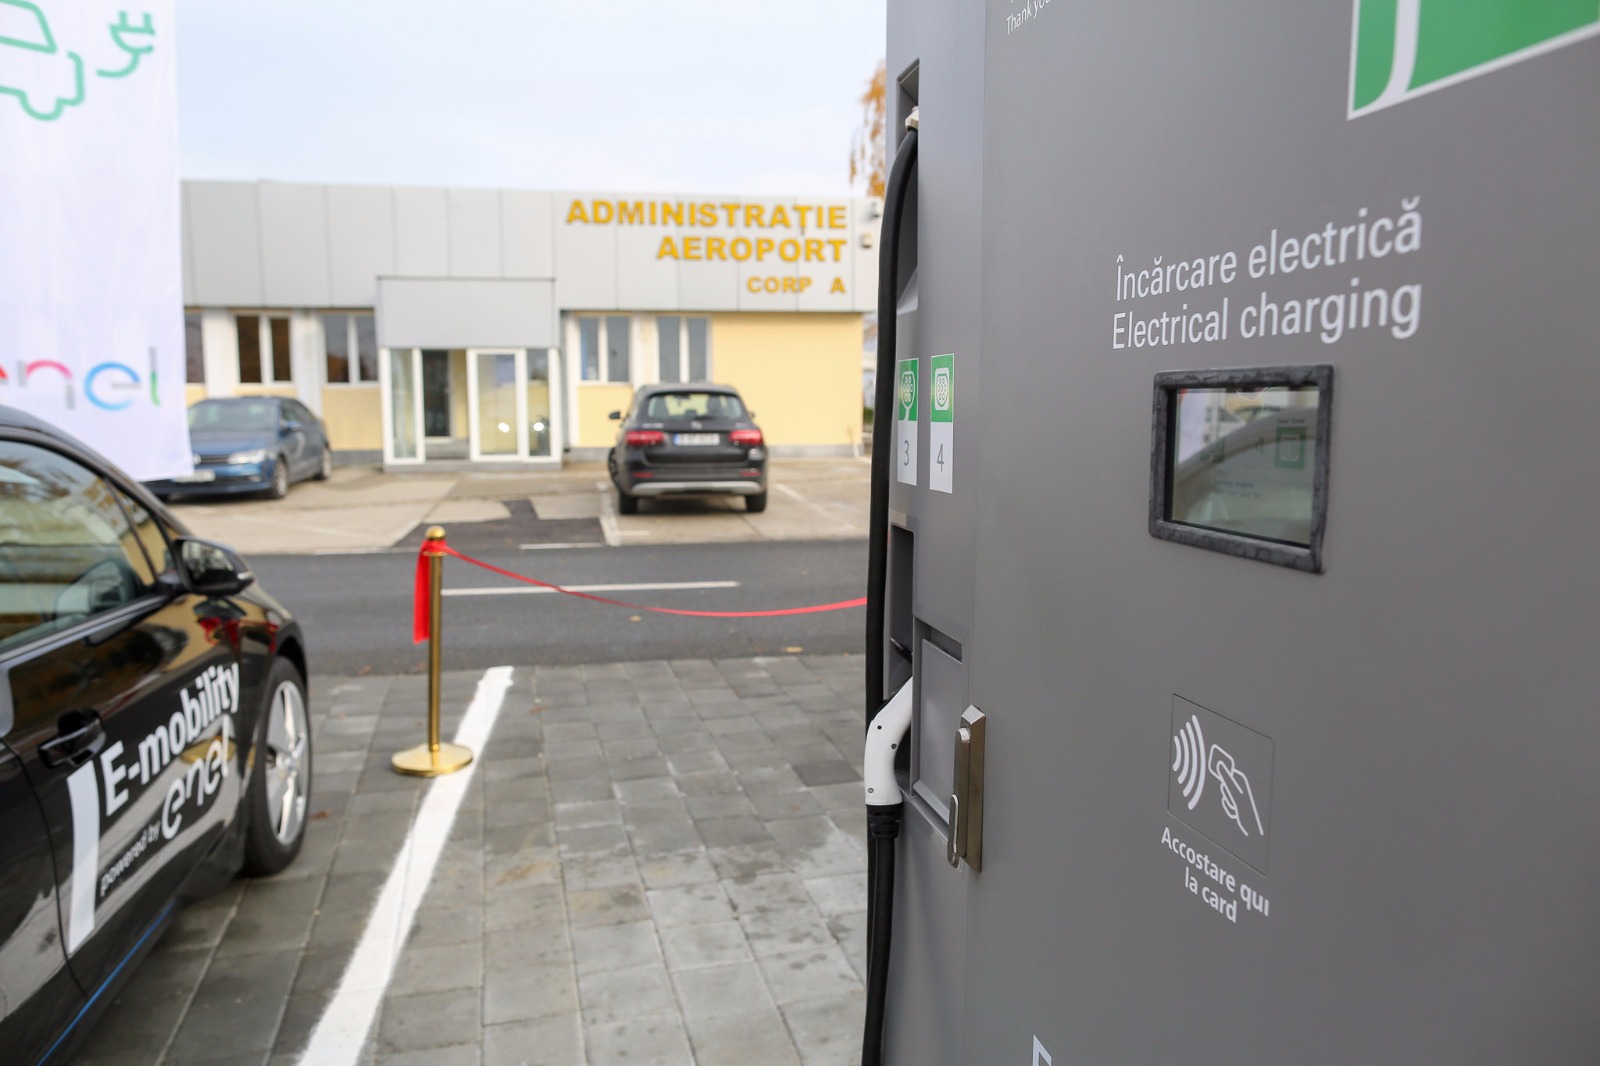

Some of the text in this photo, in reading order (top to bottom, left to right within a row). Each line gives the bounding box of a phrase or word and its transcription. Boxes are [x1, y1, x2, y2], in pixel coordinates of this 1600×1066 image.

[1006, 0, 1051, 35] Thank yo
[656, 235, 847, 262] AEROPORT
[1115, 195, 1422, 301] Încărcare electrică
[747, 275, 846, 294] CORP A
[1112, 277, 1422, 350] Electrical charging
[903, 439, 910, 467] 3
[936, 442, 945, 473] 4
[100, 661, 240, 817] E-mobility
[100, 713, 229, 897] powered by enel
[1161, 826, 1270, 917] Accostare qui
[1185, 866, 1238, 924] la card
